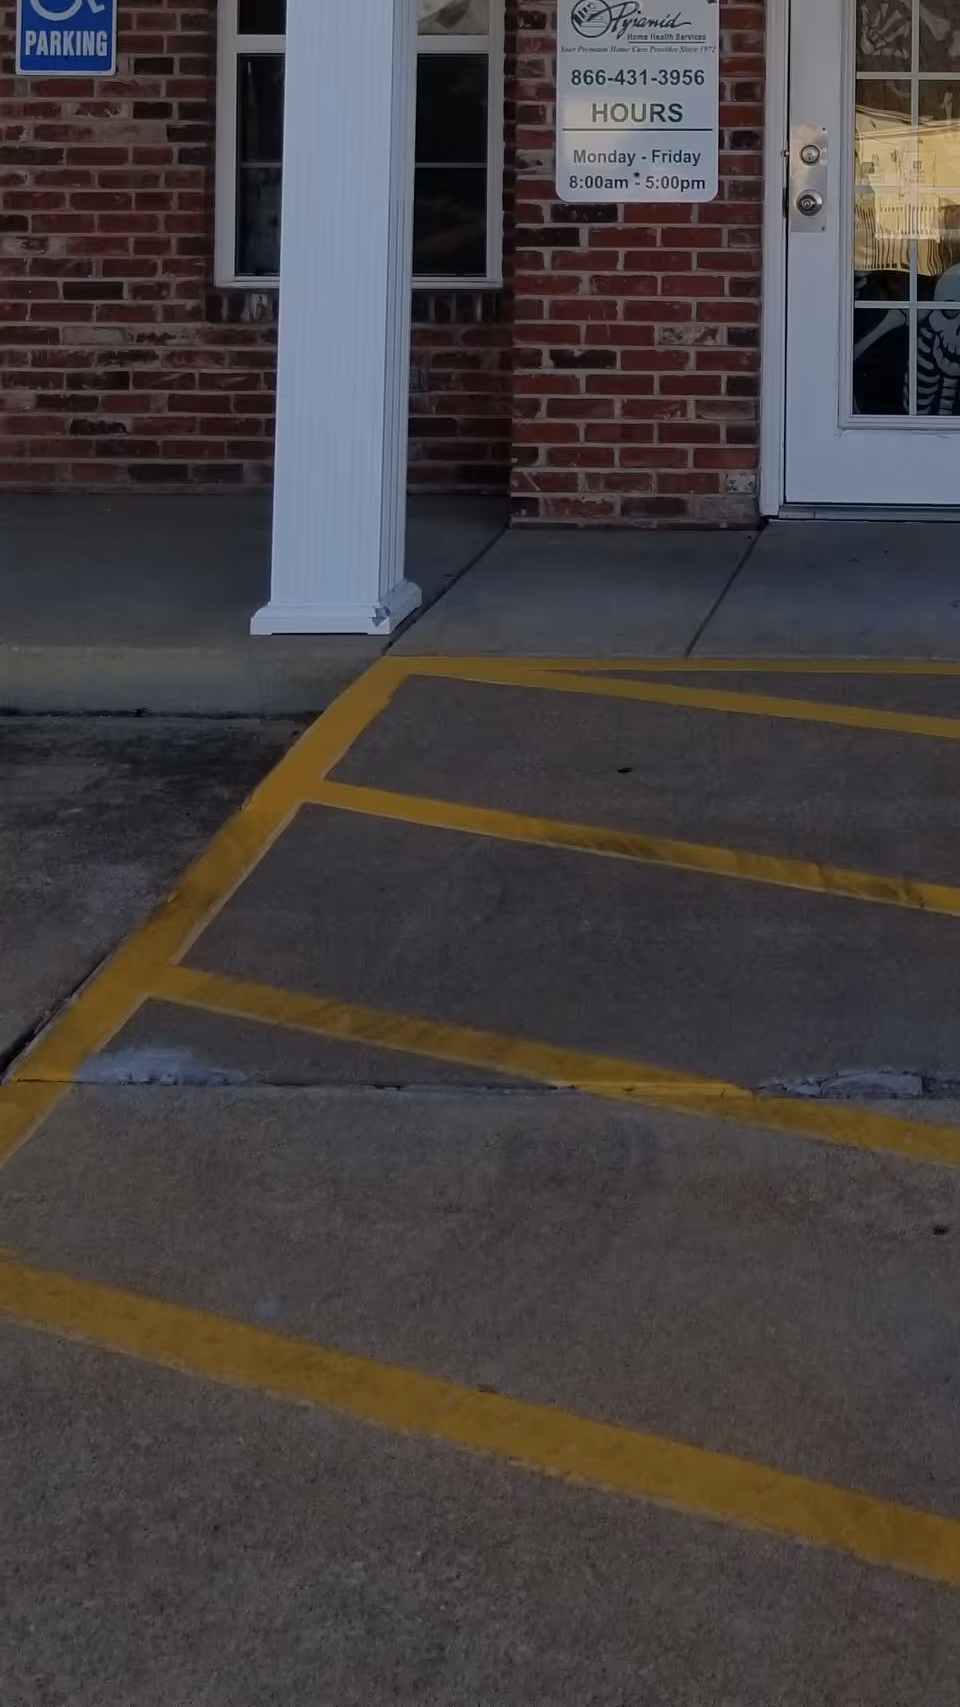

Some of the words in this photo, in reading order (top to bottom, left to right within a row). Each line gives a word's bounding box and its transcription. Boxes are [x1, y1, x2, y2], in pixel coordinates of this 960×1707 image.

[610, 1, 692, 40] Pyramid
[26, 30, 107, 56] PARKING
[571, 69, 705, 85] 866-431-3956
[592, 103, 683, 122] HOURS
[573, 150, 636, 166] Monday
[652, 150, 701, 166] Friday
[569, 175, 629, 189] 8:00am
[645, 175, 706, 192] 5:00pm
